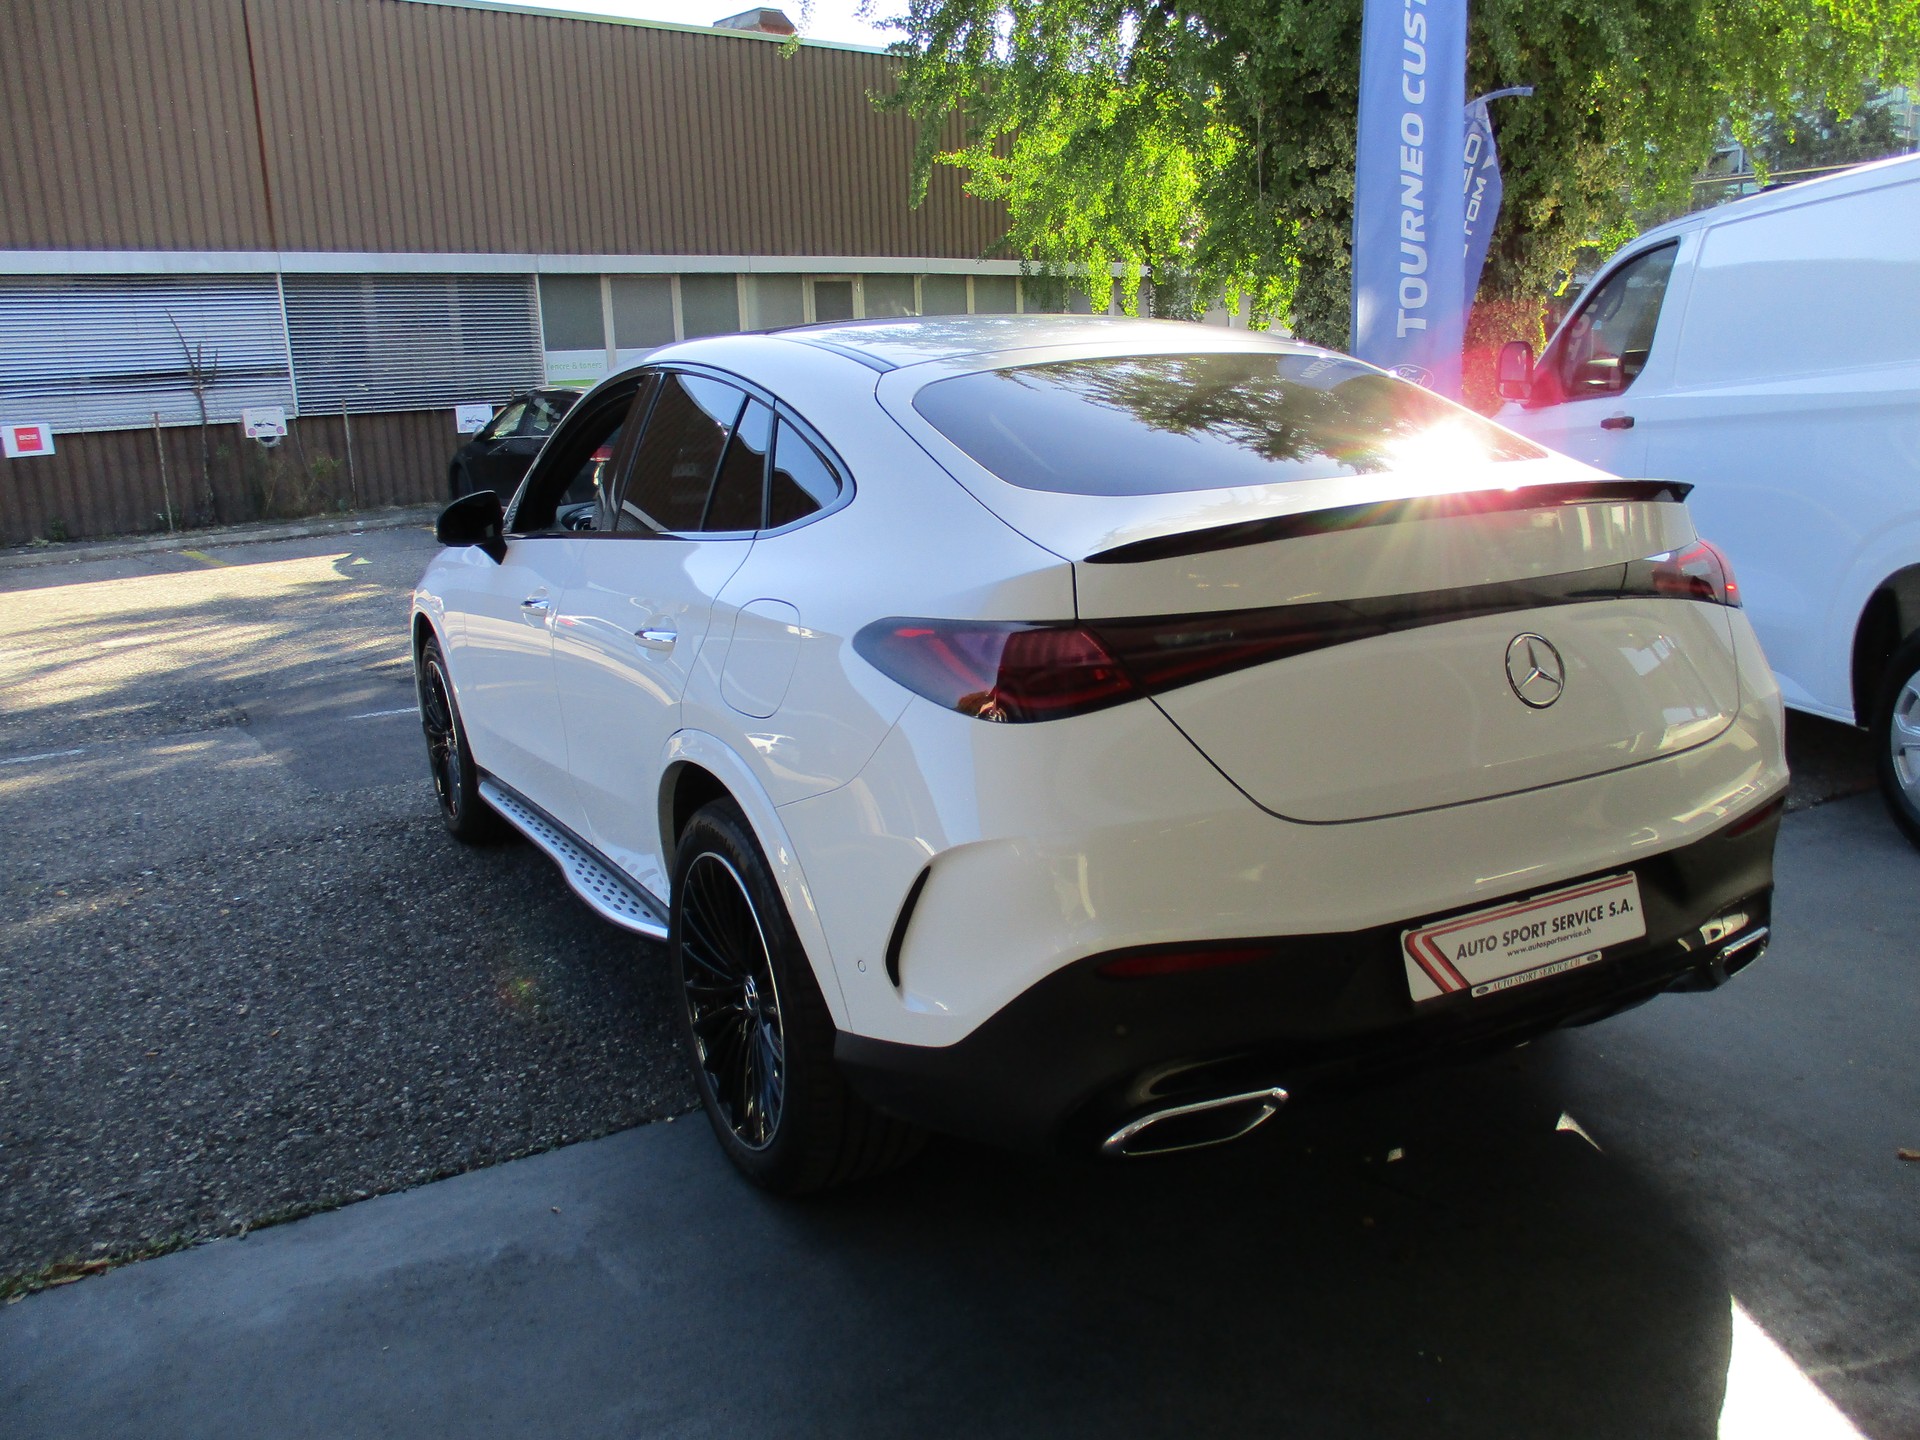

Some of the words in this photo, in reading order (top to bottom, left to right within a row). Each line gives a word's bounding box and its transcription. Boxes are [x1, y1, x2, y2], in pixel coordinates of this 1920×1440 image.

[1397, 112, 1428, 338] TOURNEO
[580, 361, 603, 369] toners
[1457, 935, 1498, 960] AUTO
[1502, 921, 1547, 947] SPORT
[1552, 905, 1603, 933] SERVICE
[1609, 898, 1634, 917] S.A.
[1507, 927, 1592, 957] www.autosportservice.ch
[1493, 979, 1513, 991] AUTO
[1515, 972, 1537, 985] SPORT
